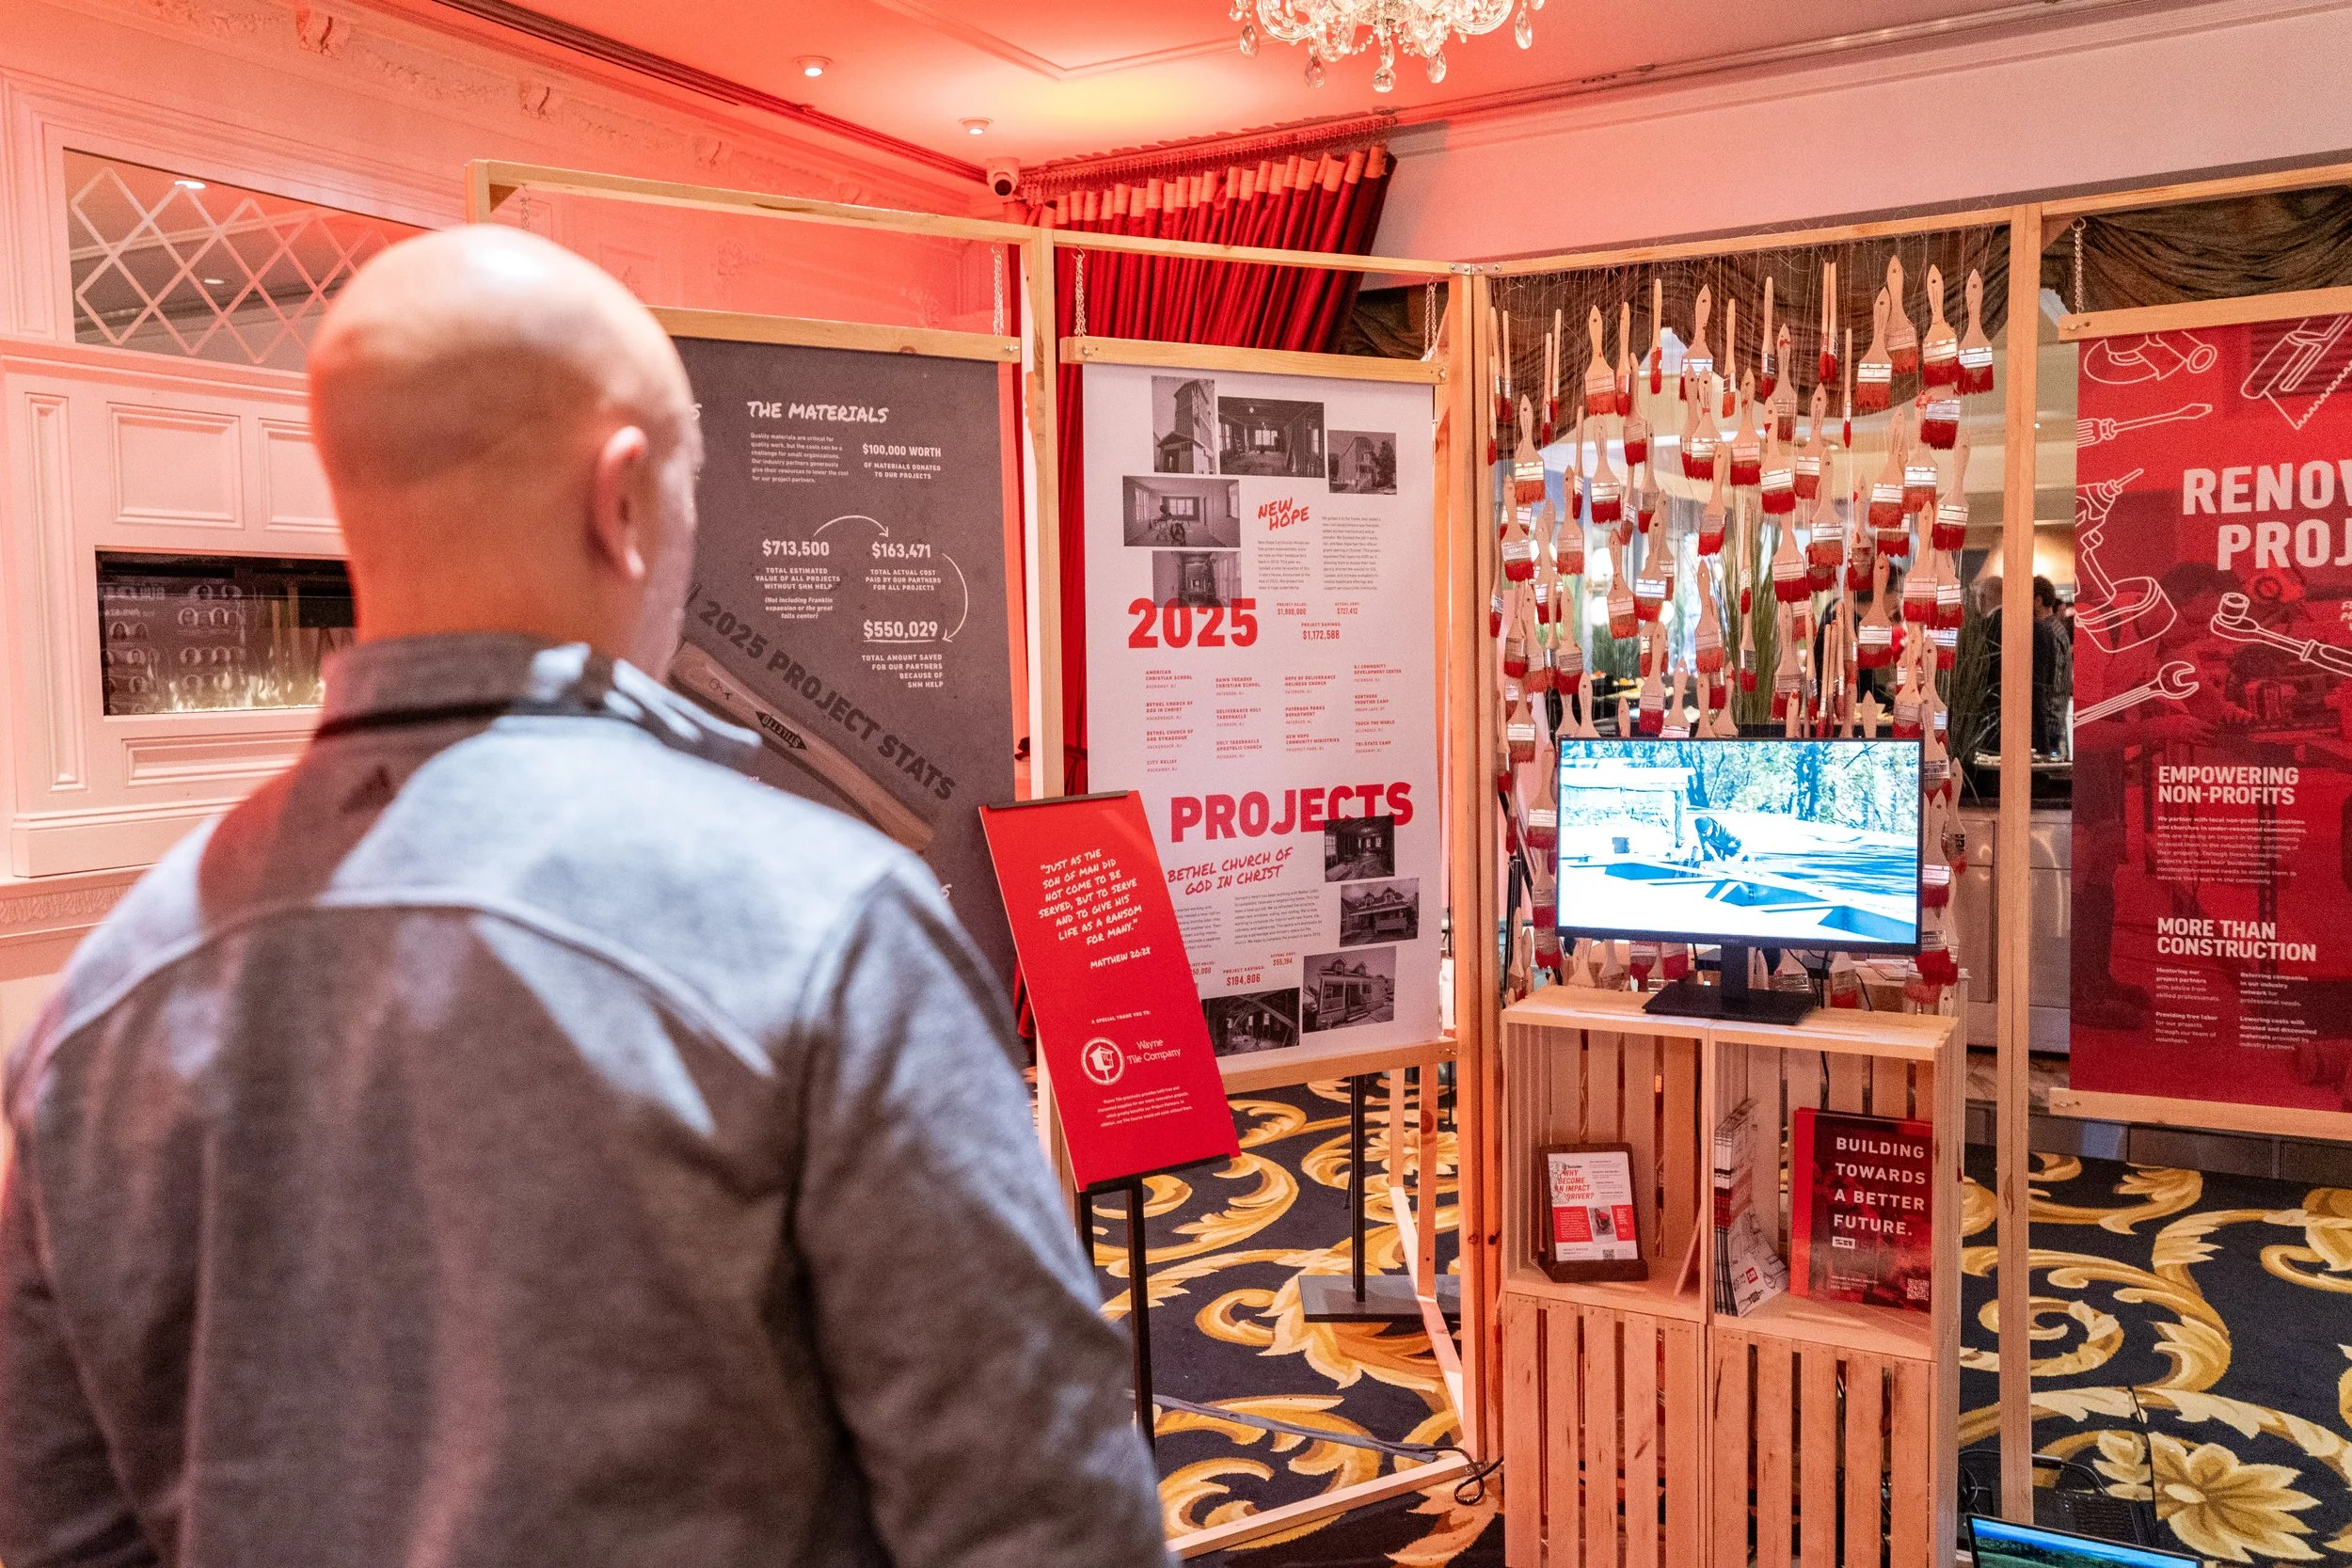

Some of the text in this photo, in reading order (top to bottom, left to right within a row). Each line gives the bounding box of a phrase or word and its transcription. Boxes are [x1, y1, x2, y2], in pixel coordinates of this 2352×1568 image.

[747, 401, 889, 423] THE MATERIALS
[751, 432, 770, 440] Quality
[751, 450, 778, 458] challenge
[863, 442, 942, 458] $100,000 WORTH
[874, 462, 911, 470] MATERIALS
[1257, 497, 1293, 519] NEW
[1269, 506, 1310, 531] HOPE
[762, 538, 830, 558] $713,500
[871, 541, 931, 560] $163,471
[779, 596, 807, 605] including
[864, 619, 939, 640] $550,029
[1128, 597, 1258, 649] 2025
[1302, 629, 1340, 641] $1,172,588
[698, 599, 957, 800] 2025 PROJECT STATS
[762, 714, 802, 749] STILETTO
[2158, 765, 2299, 785] EMPOWERING
[2158, 784, 2296, 805] NON-PROFITS
[1170, 782, 1413, 843] PROJECTS
[1041, 848, 1102, 875] "JUST AS THE
[1168, 847, 1294, 883] BETHEL CHURCH OF
[1042, 858, 1116, 890] SON OF MAN DID
[1184, 863, 1284, 895] GOD IN CHRIST
[1045, 869, 1121, 903] NOT COME TO BE
[1039, 878, 1137, 919] SERVED, BUT TO SERVE
[1056, 894, 1129, 927] AND TO GIVE HIS
[1057, 904, 1142, 942] LIFE AS A RANSOM
[1086, 918, 1138, 946] FOR MANY."
[2157, 917, 2277, 941] MORE THAN
[1090, 946, 1152, 969] MATTHEW 20:28
[2156, 936, 2316, 962] CONSTRUCTION
[1227, 973, 1261, 987] $194,806
[1095, 1016, 1116, 1024] SPECIAL
[1136, 1038, 1164, 1051] Wayne
[1127, 1048, 1182, 1065] Tile Company
[1836, 1136, 1925, 1159] BUILDING
[1835, 1163, 1926, 1185] TOWARDS
[1835, 1188, 1925, 1212] A BETTER
[1834, 1213, 1913, 1237] FUTURE.
